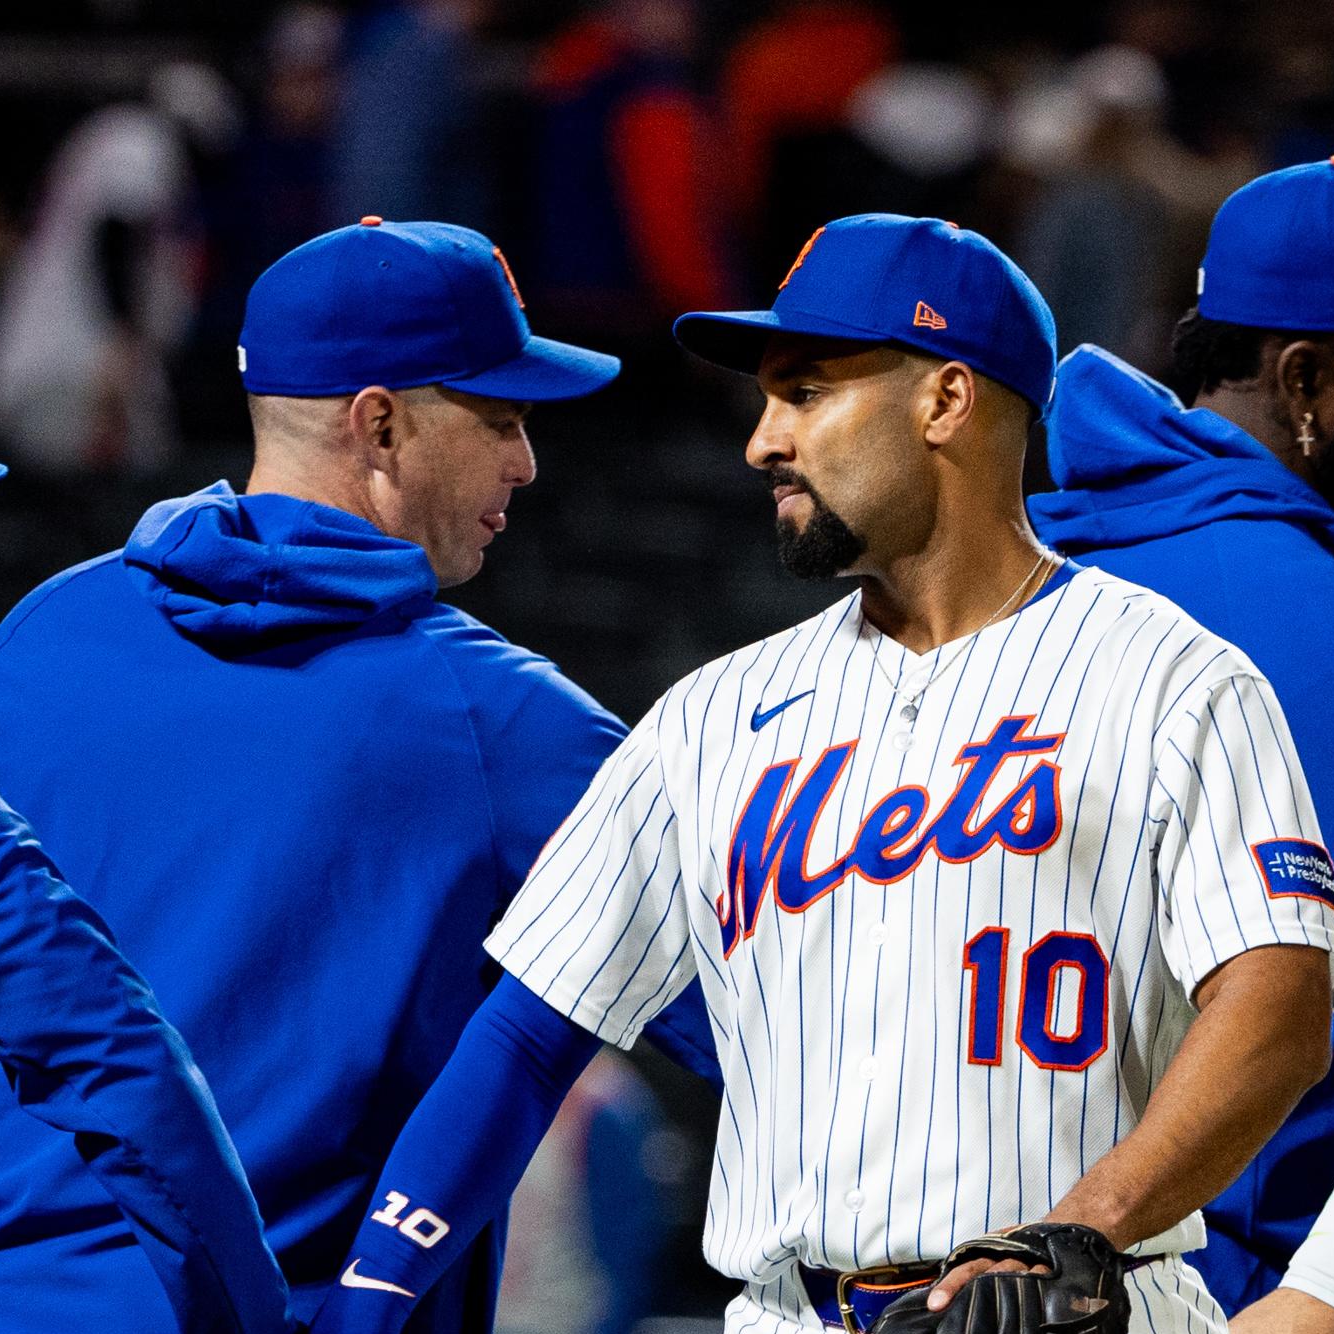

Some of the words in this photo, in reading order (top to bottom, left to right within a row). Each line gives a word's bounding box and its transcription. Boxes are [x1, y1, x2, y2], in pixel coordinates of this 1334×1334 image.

[716, 714, 1068, 961] Mets
[962, 926, 1110, 1071] 10
[370, 1190, 450, 1248] 10
